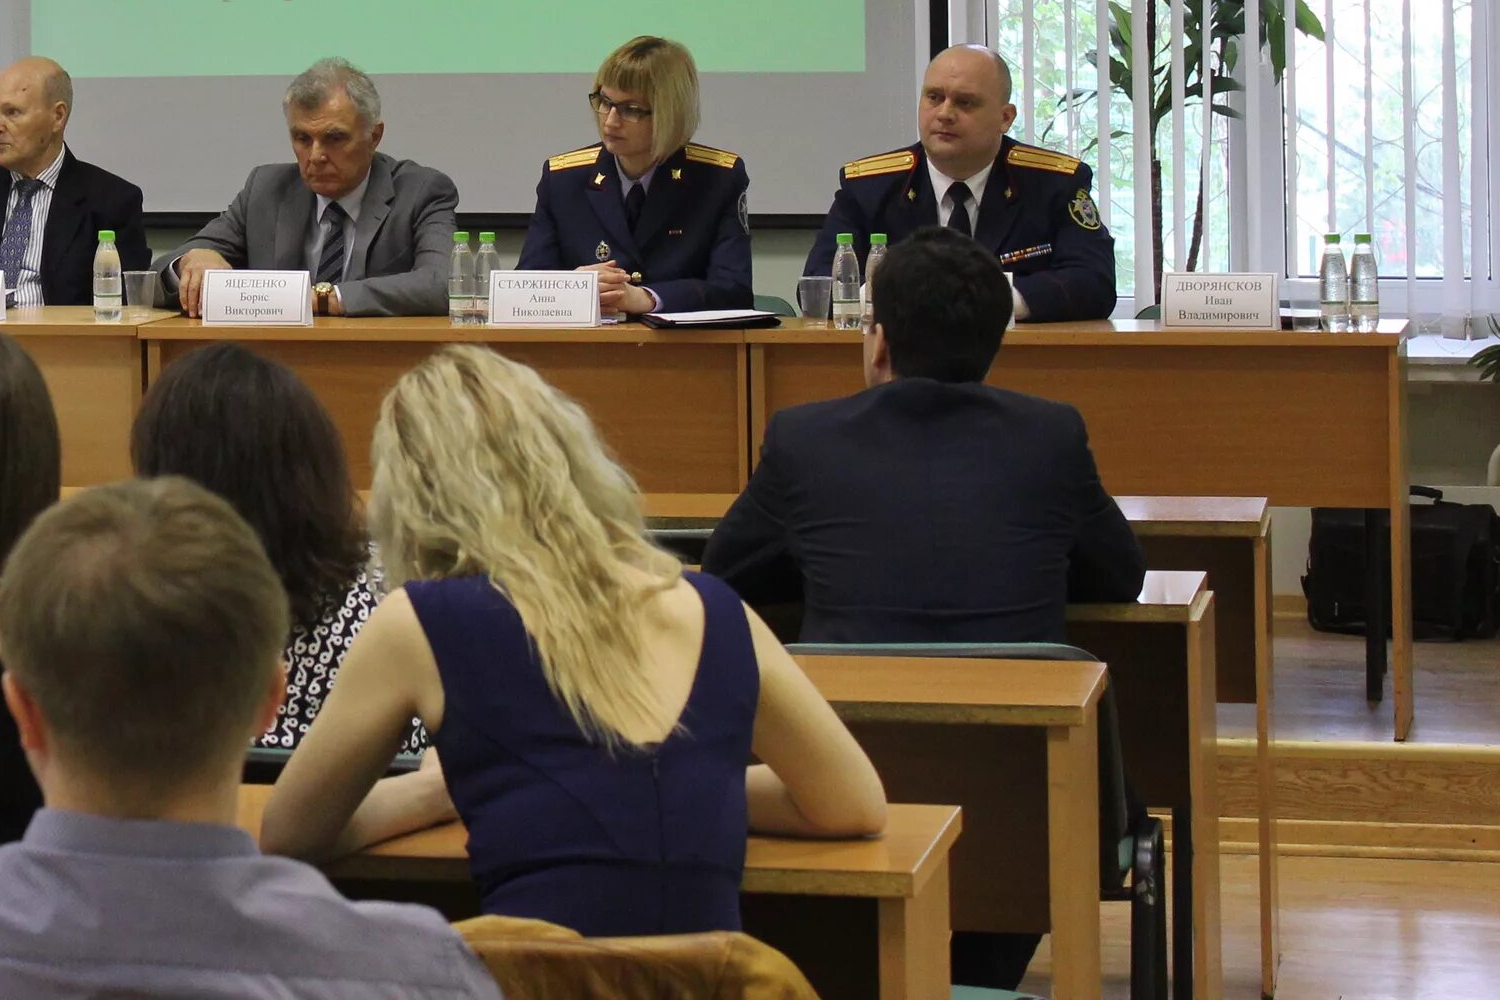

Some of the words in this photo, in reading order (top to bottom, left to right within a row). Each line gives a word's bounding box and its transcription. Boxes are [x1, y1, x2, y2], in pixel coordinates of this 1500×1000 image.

[225, 279, 287, 289] ЯЦЕЛЕНКО
[498, 279, 588, 290] СТАРЖИНСКАЯ
[1176, 281, 1262, 292] ДВОРЯНСКОВ
[240, 292, 269, 304] Борис
[529, 294, 556, 303] Анна
[1205, 296, 1233, 305] Иван
[225, 305, 283, 317] Викторович
[512, 307, 572, 317] Николаевна
[1178, 309, 1260, 322] Владимирович
